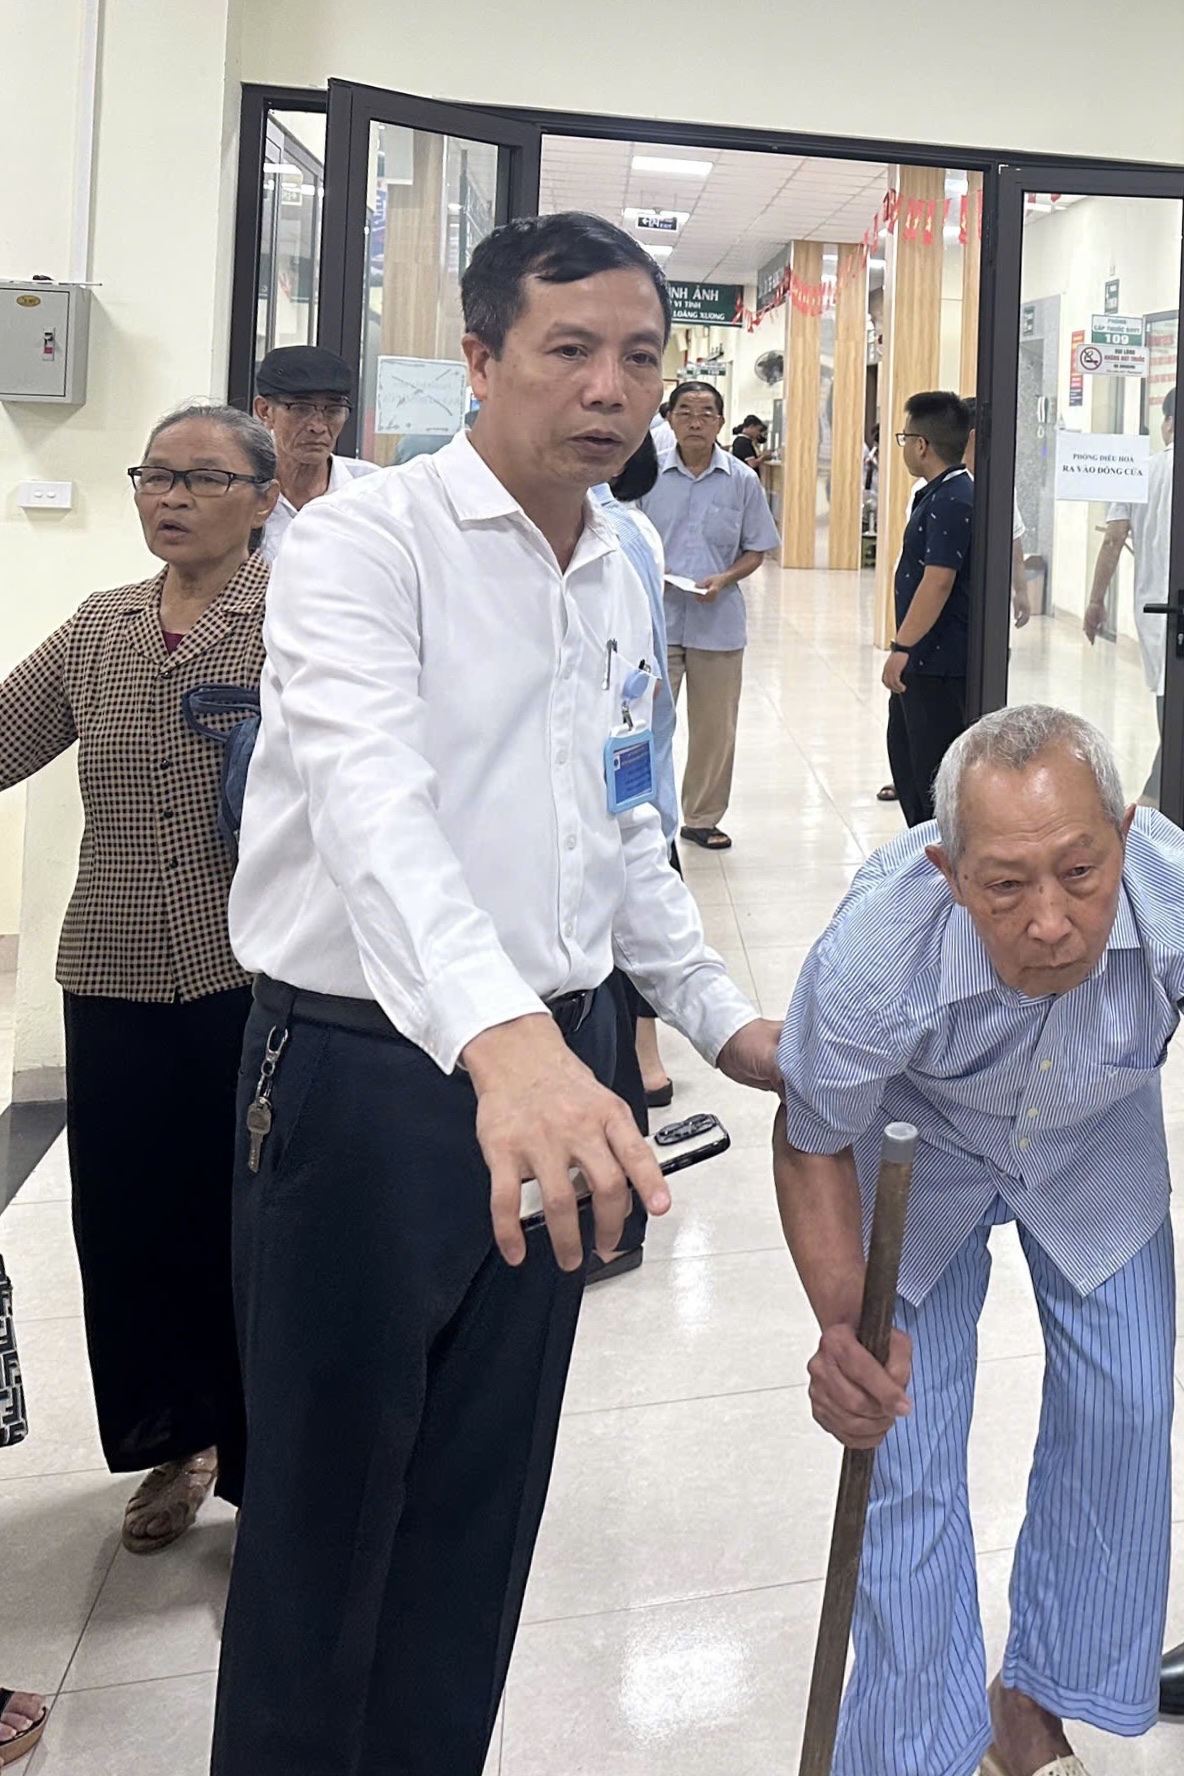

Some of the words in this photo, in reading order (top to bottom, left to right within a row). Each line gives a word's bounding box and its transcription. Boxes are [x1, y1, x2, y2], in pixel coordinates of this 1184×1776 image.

[692, 284, 719, 302] ẢNH
[1105, 333, 1129, 345] 109
[1062, 464, 1075, 473] RA
[1077, 464, 1096, 473] VÀO
[1097, 465, 1123, 475] ĐÓNG
[1124, 467, 1143, 476] CỬA
